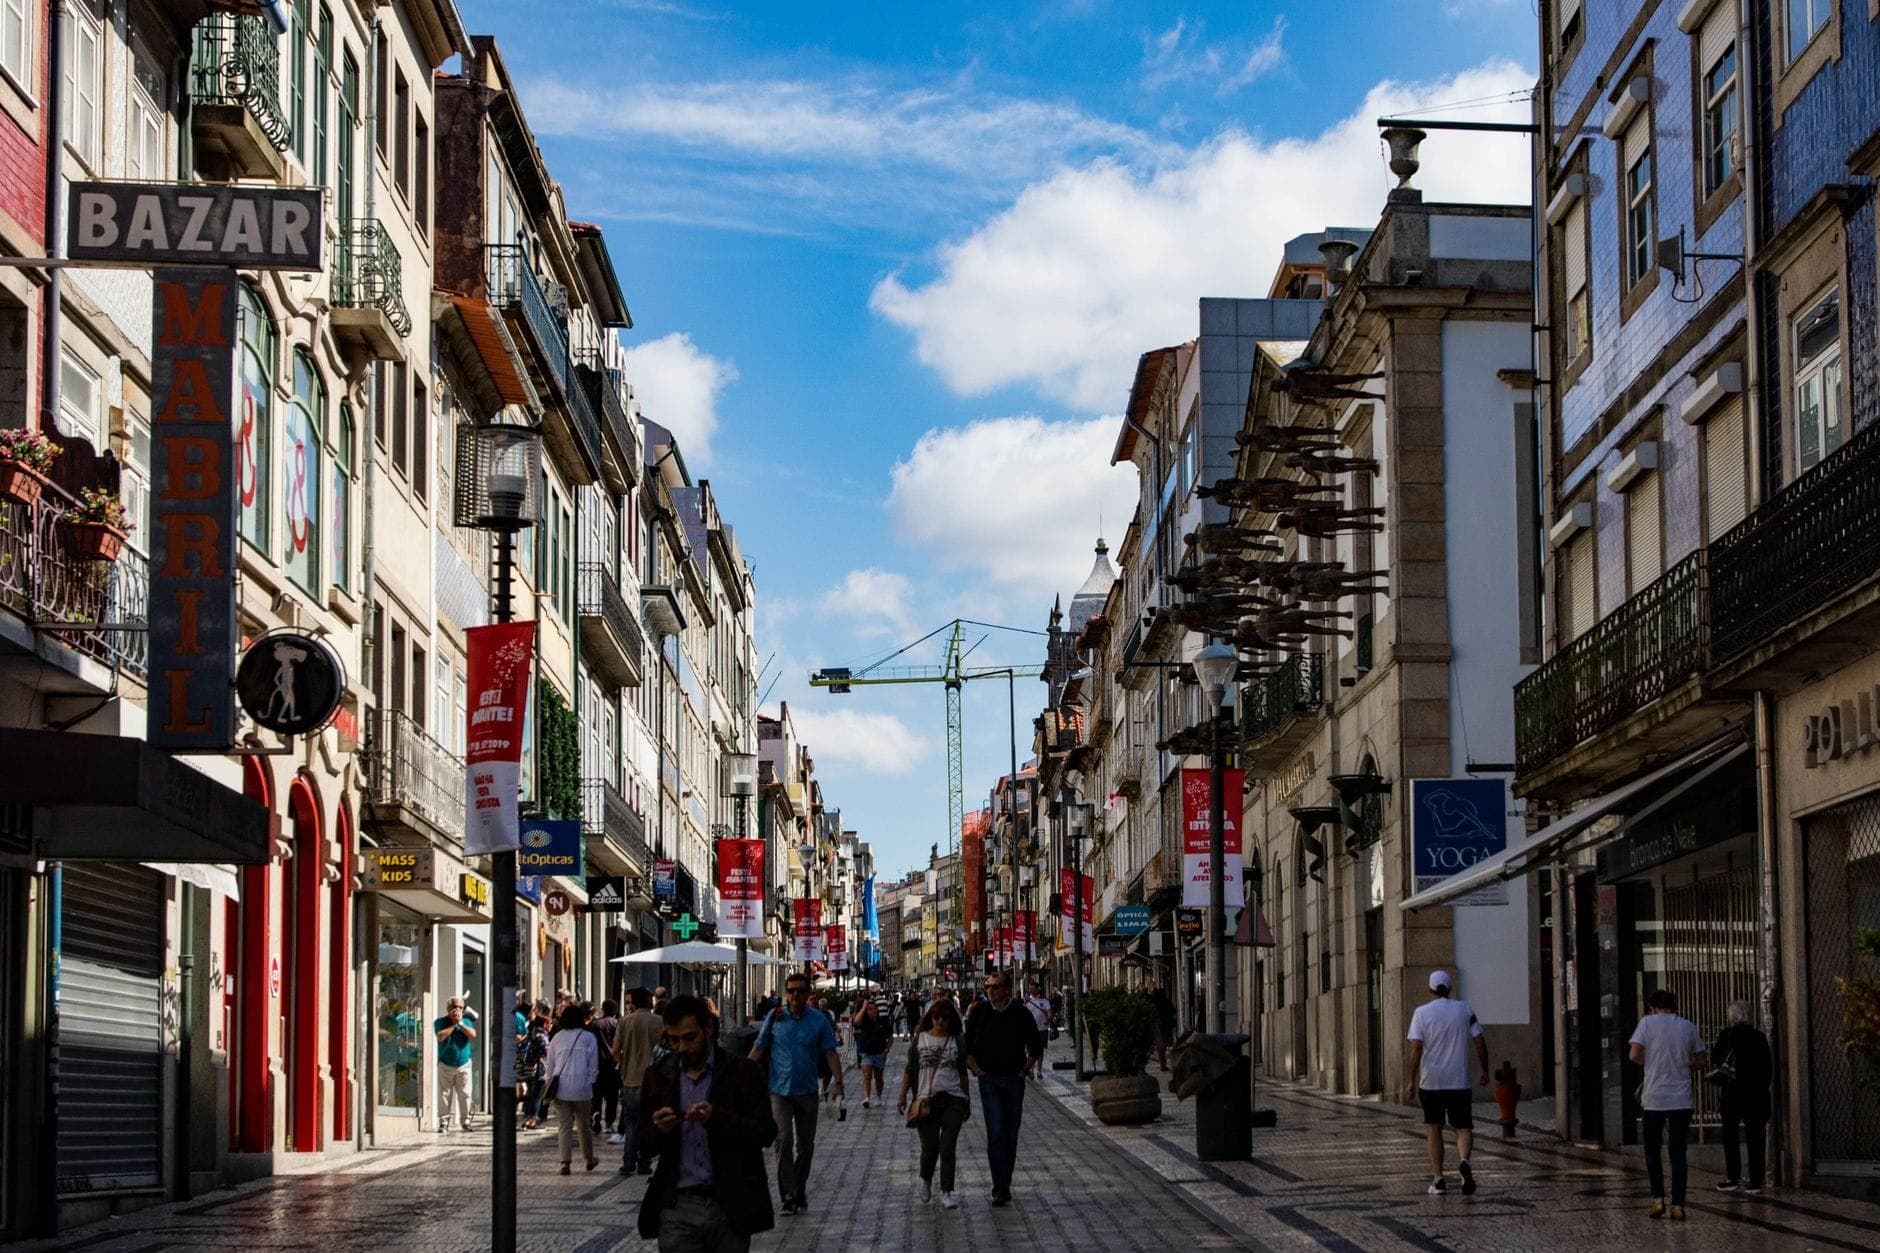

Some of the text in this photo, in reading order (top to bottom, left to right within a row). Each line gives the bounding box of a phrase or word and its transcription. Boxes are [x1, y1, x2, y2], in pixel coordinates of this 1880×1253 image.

[78, 192, 311, 255] BAZAR
[157, 281, 230, 734] MABRIL
[379, 854, 417, 866] MASS
[381, 870, 413, 882] KIDS
[591, 896, 623, 904] adidas
